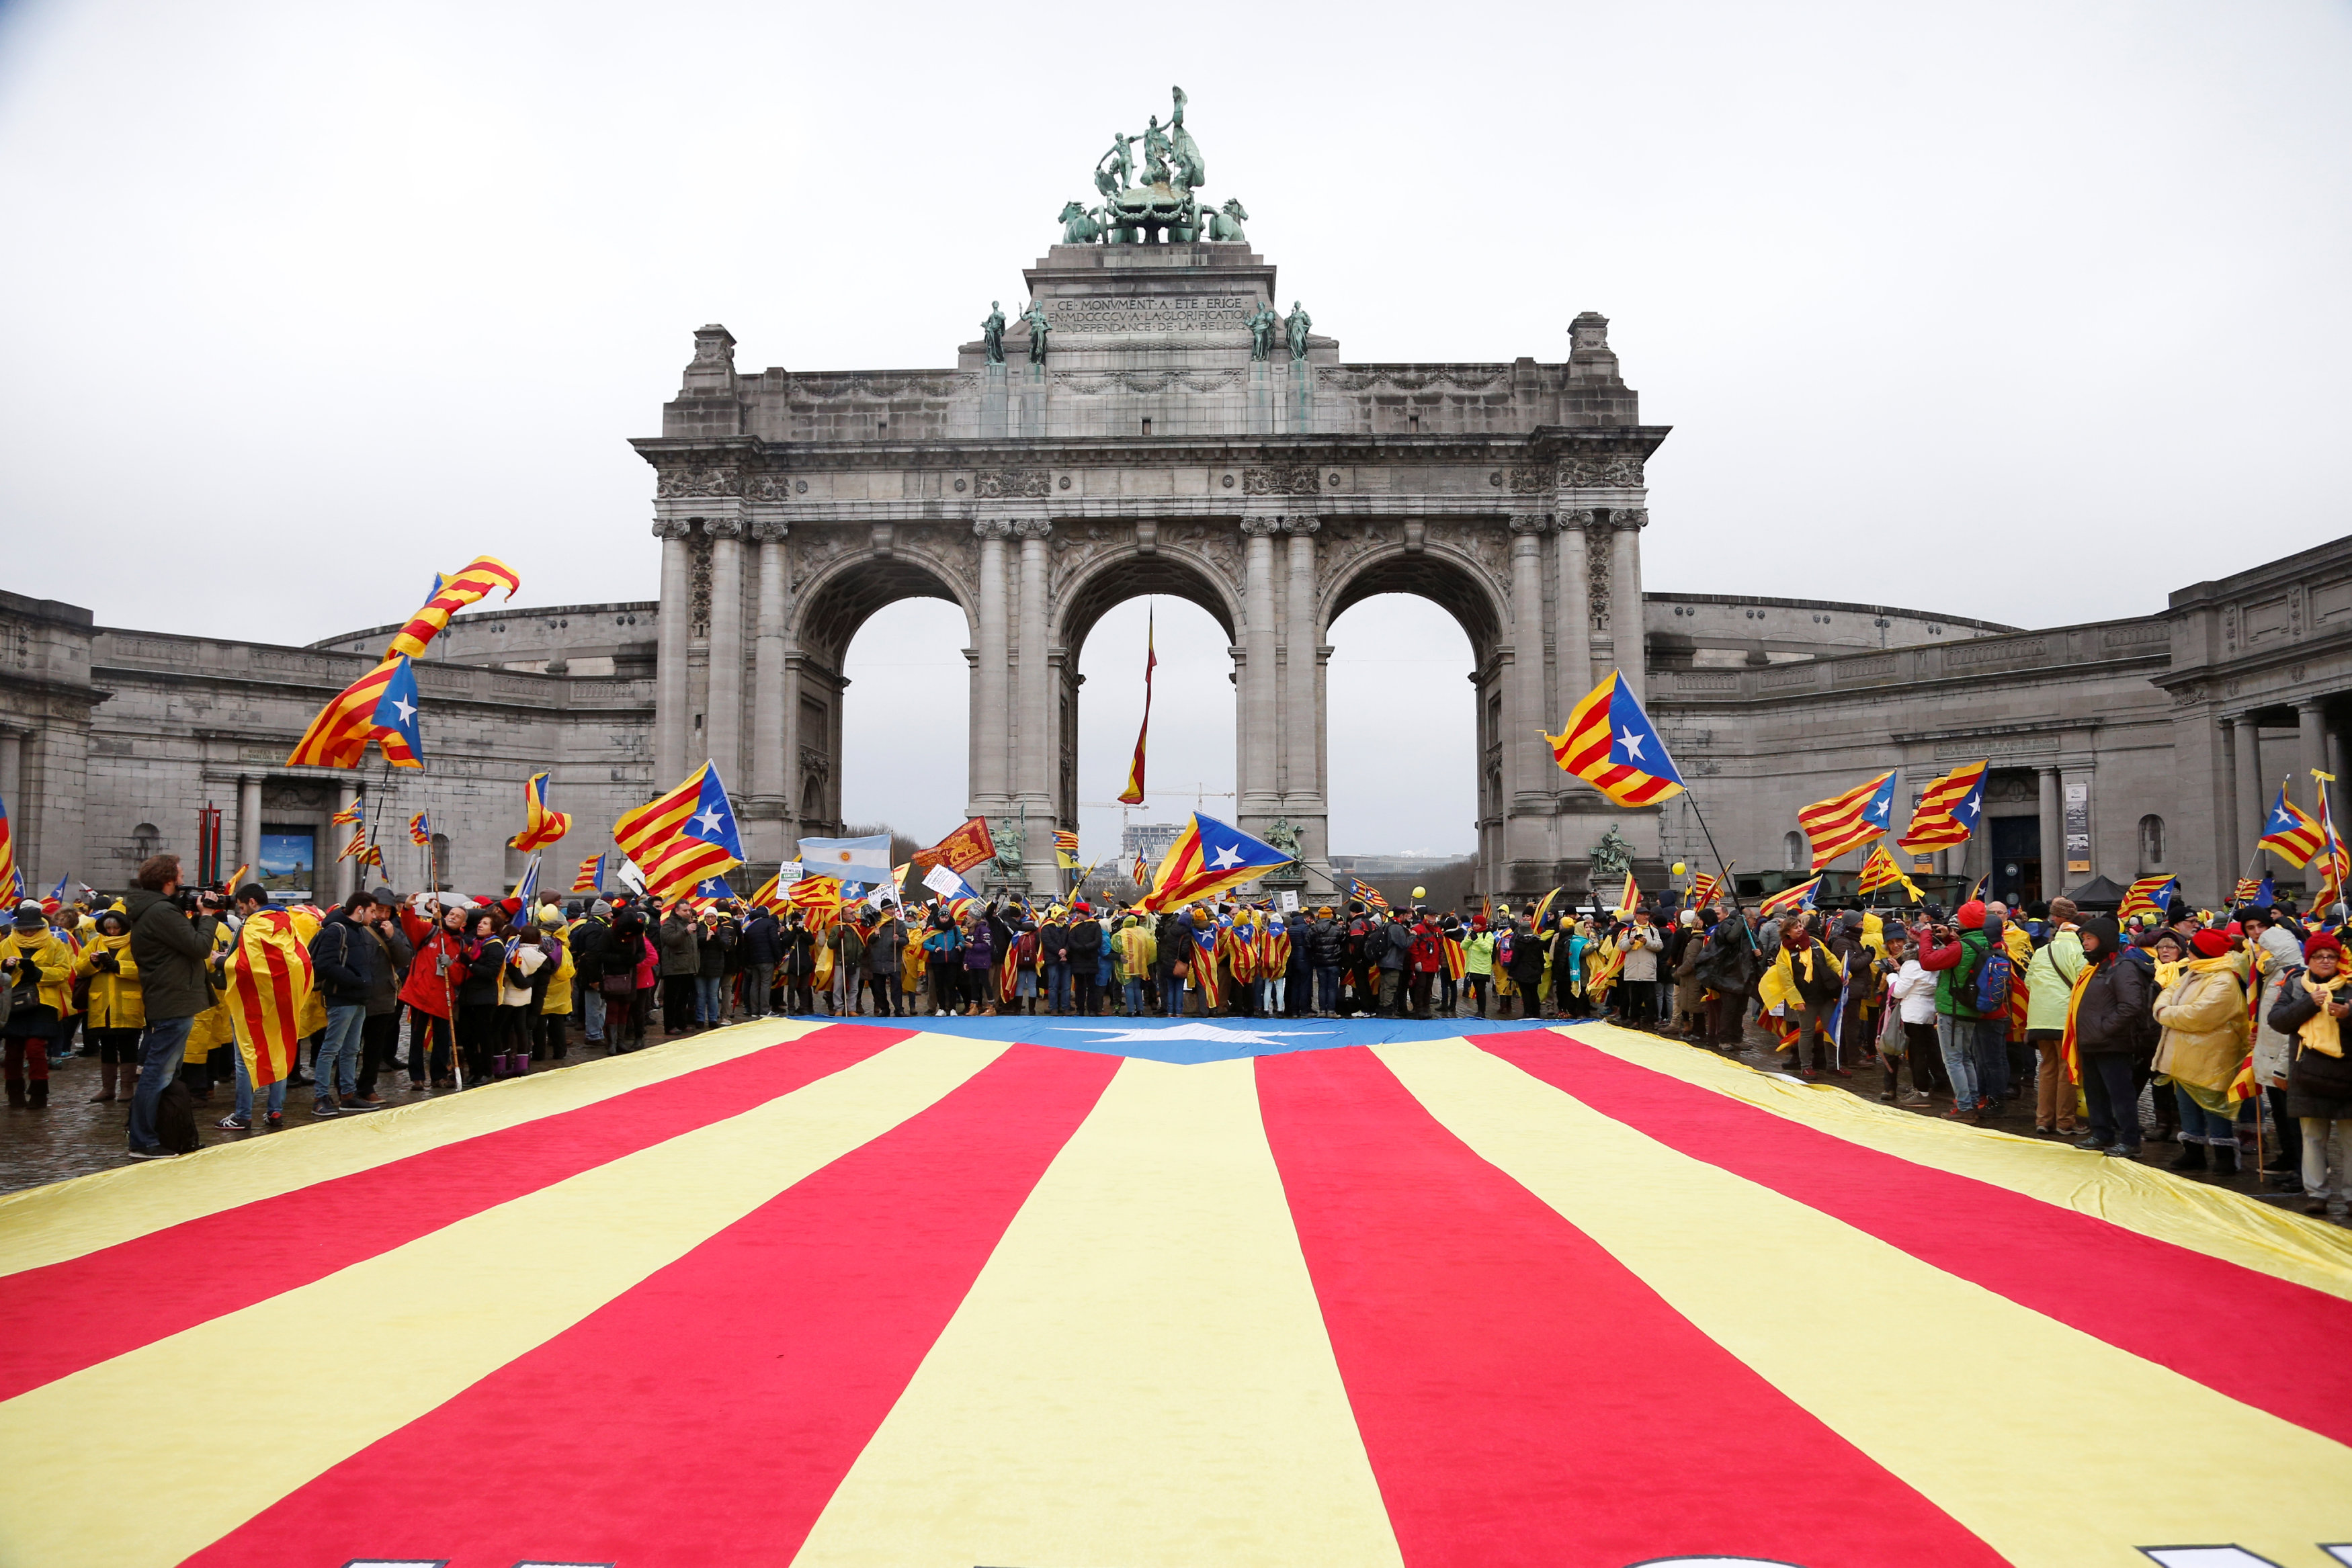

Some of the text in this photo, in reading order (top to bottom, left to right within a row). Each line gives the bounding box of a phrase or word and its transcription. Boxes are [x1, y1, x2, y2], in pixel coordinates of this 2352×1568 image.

[1058, 298, 1242, 310] CE MONVMENT A ETE ERIGE
[1048, 312, 1064, 322] EN
[1066, 312, 1127, 322] MDCCCCV
[1131, 312, 1140, 321] A
[1145, 312, 1161, 321] LA
[1158, 322, 1174, 331] DE
[1179, 322, 1194, 331] LA
[869, 885, 892, 897] FREEDOM
